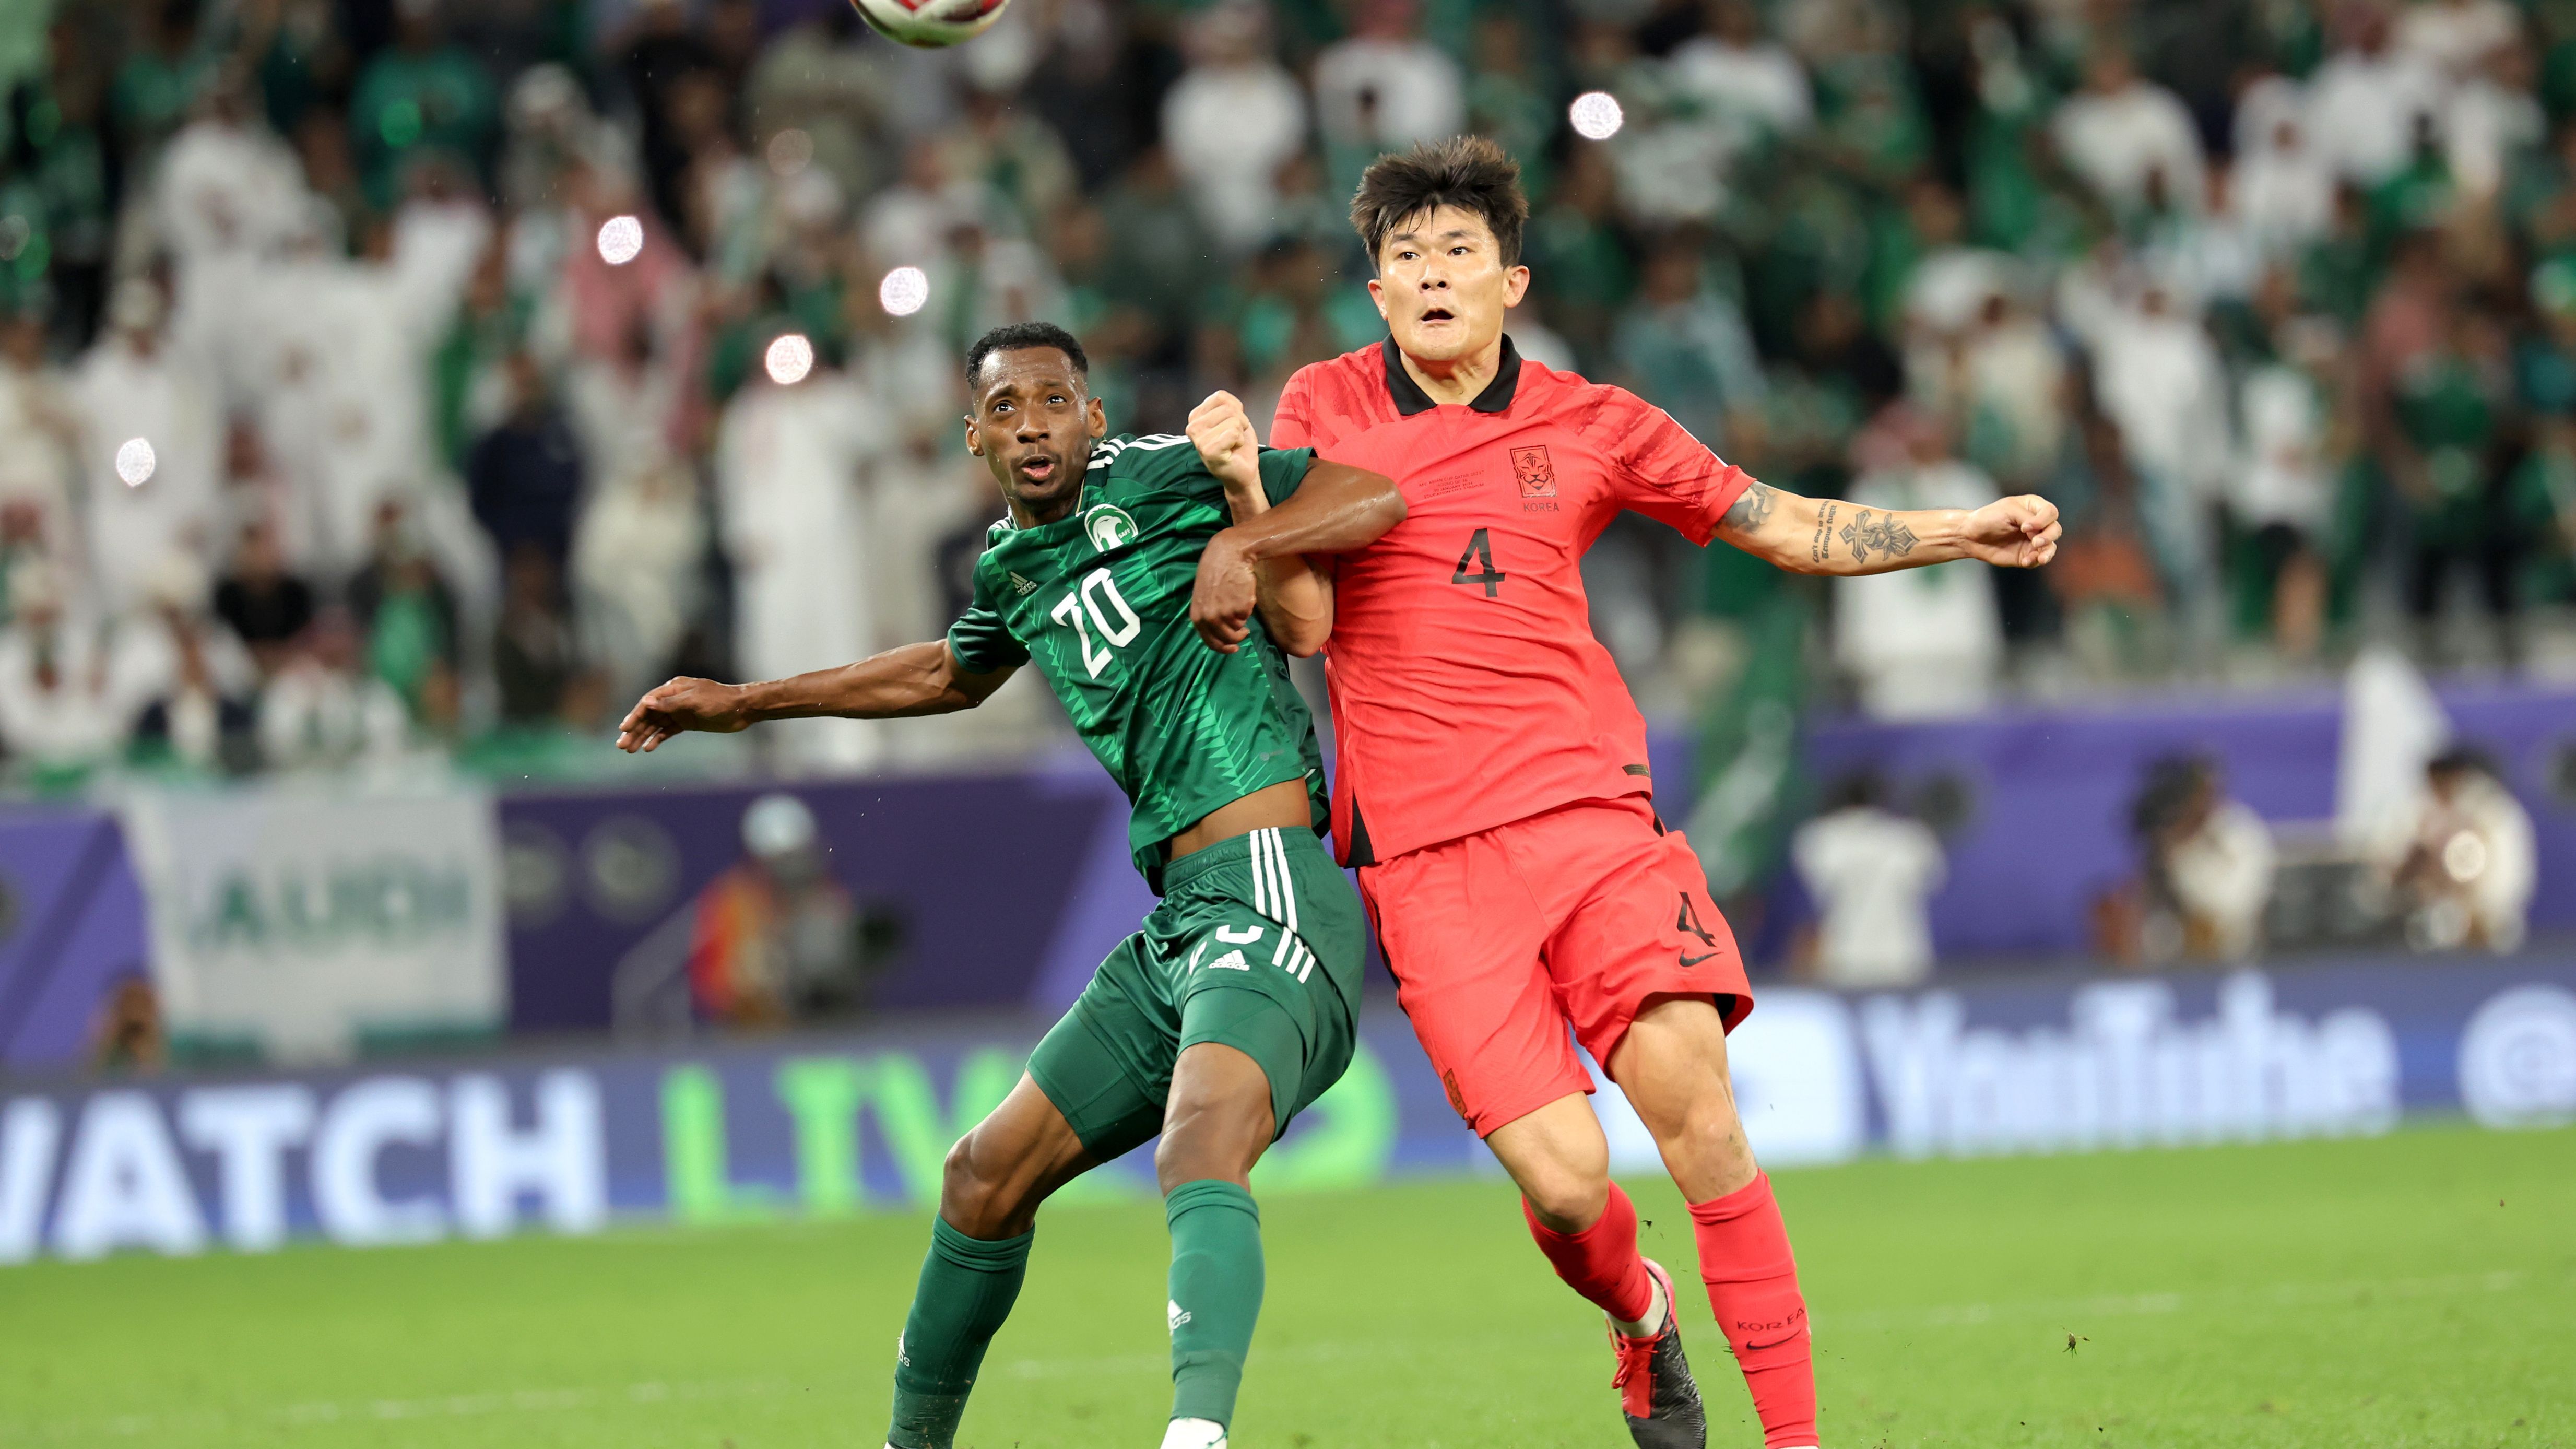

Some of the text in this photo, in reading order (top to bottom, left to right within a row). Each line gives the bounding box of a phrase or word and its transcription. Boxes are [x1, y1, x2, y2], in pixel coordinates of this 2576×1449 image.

[1523, 502, 1560, 512] KOREA
[1118, 528, 1130, 539] SAFF
[1822, 526, 1832, 559] Tempus
[1452, 528, 1506, 598] 4
[1051, 567, 1141, 679] 20
[1676, 891, 1717, 948] 4
[1858, 967, 2402, 1160] YouTube
[1736, 1307, 1805, 1332] KOREA
